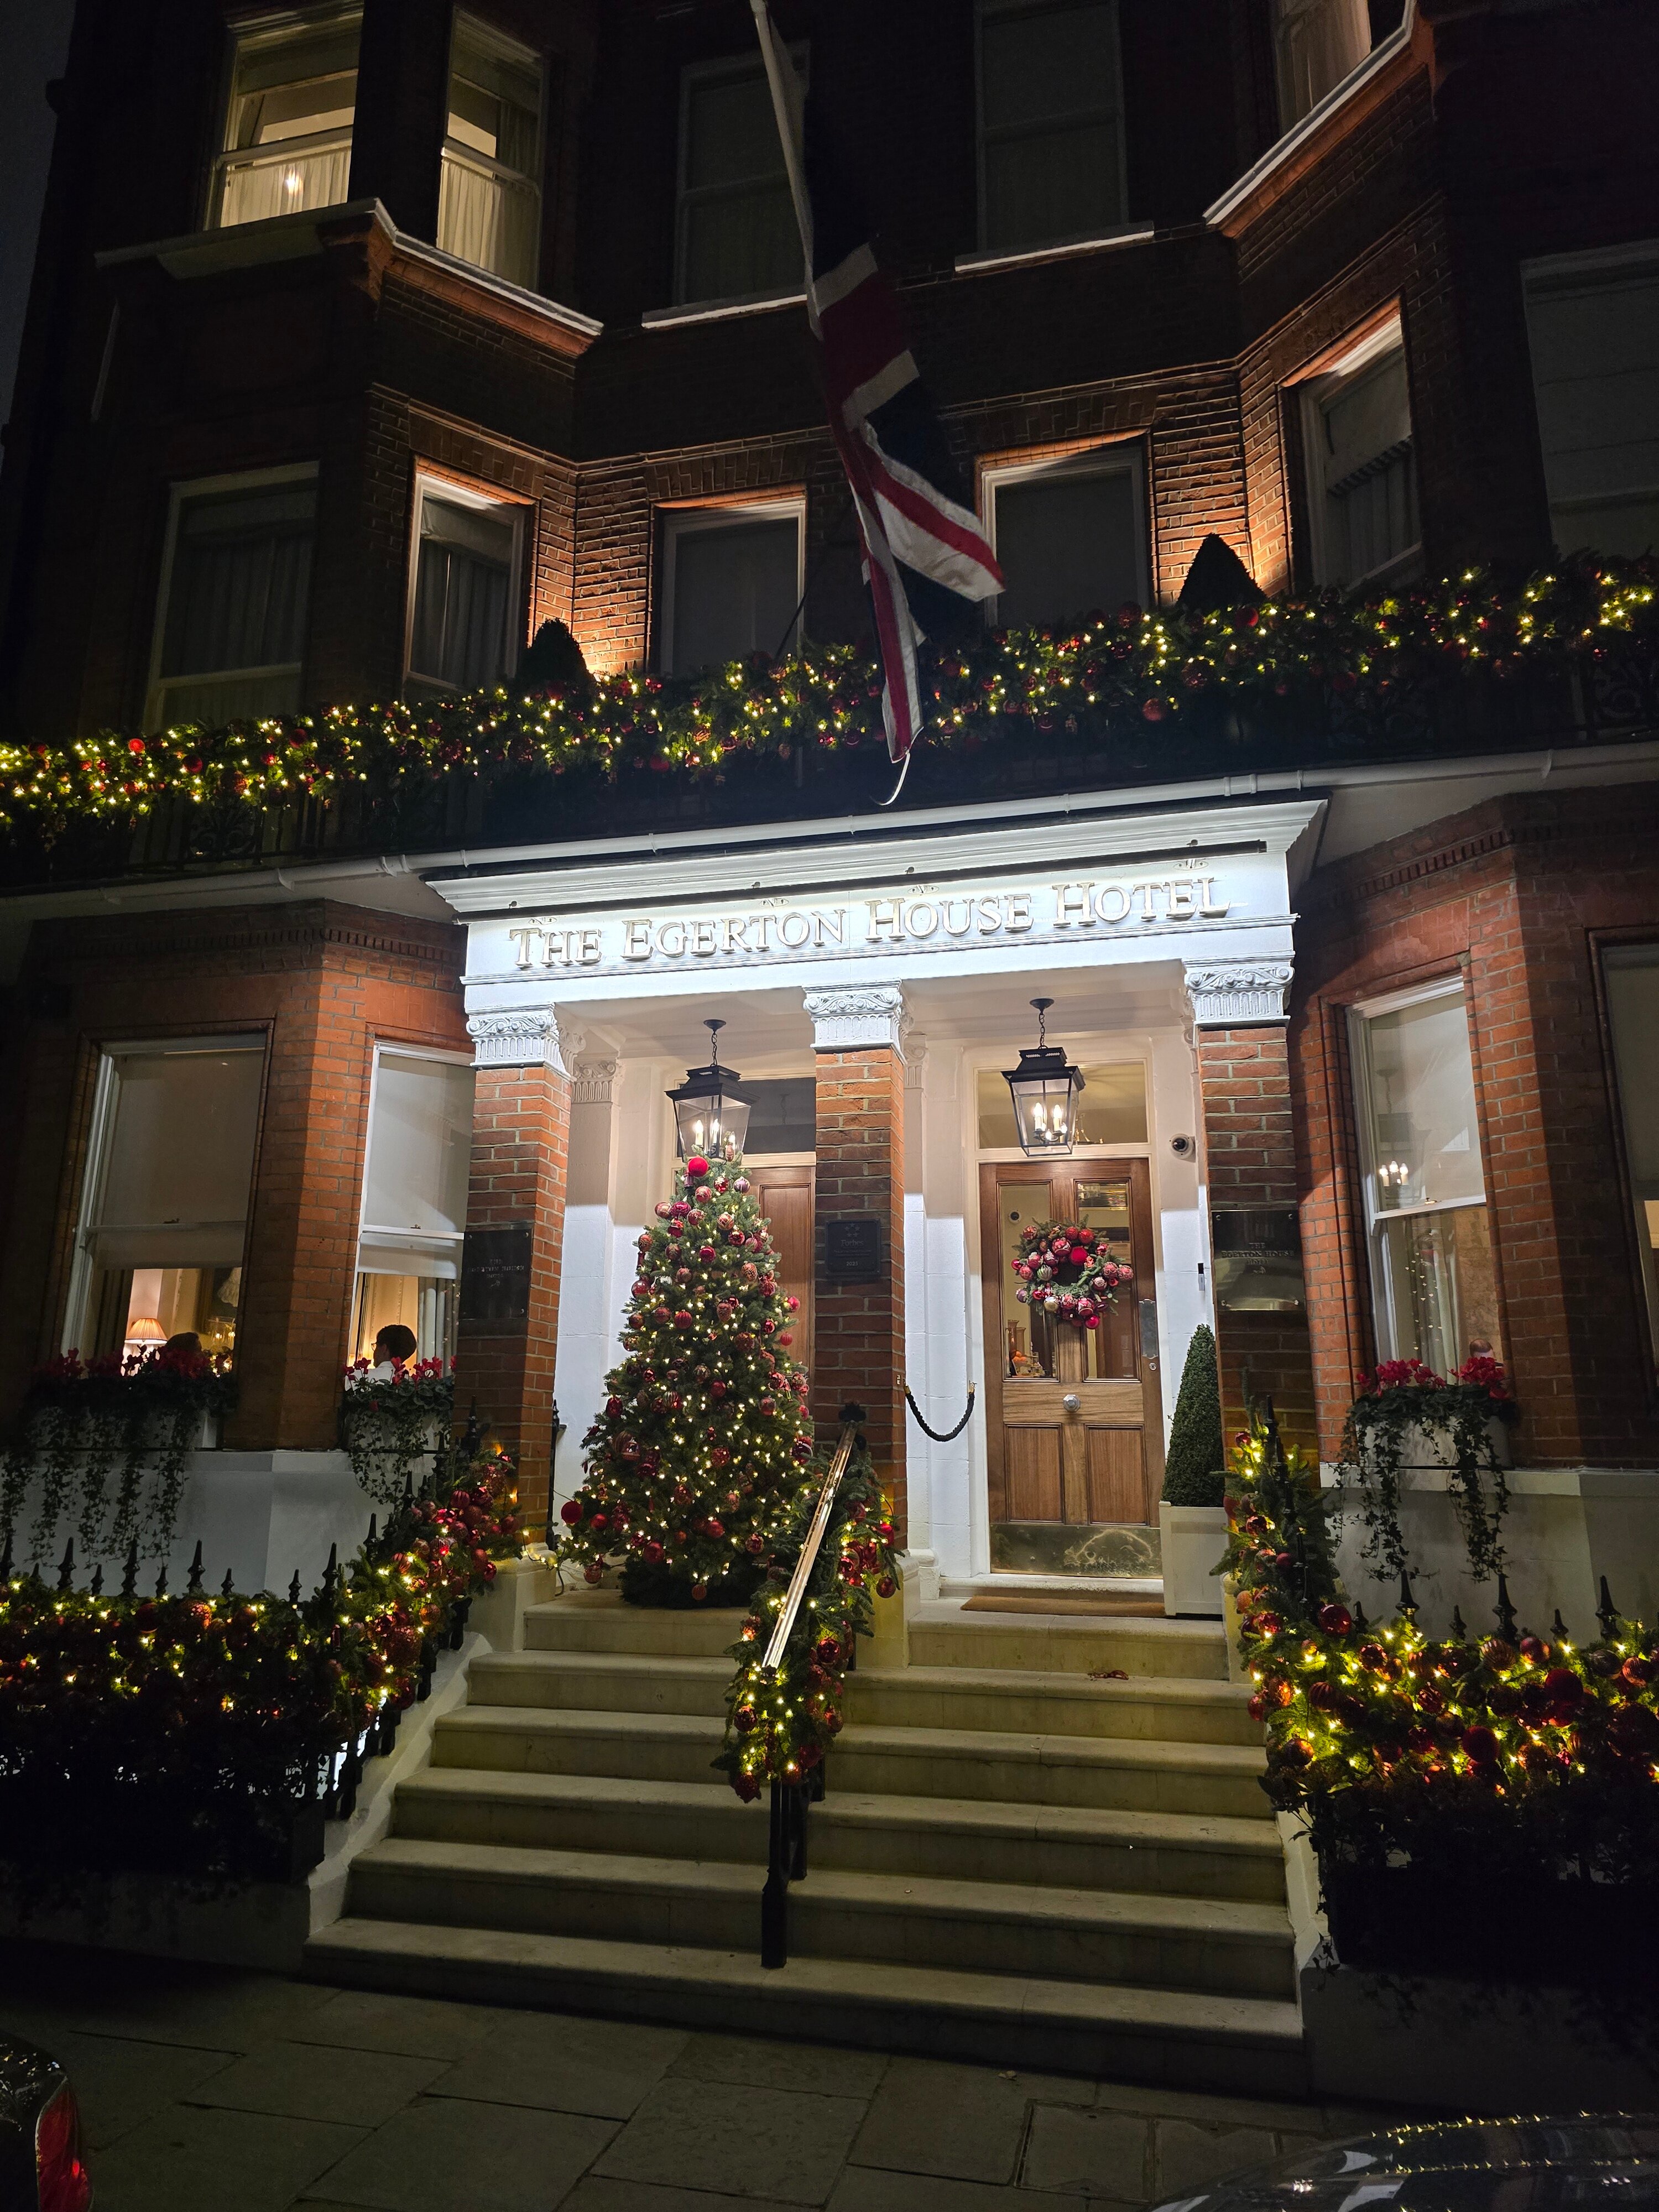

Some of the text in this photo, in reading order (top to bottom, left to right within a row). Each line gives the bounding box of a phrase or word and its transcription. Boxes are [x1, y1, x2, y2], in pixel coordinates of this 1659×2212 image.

[509, 877, 1230, 968] THE EGERTON HOUSE HOTEL
